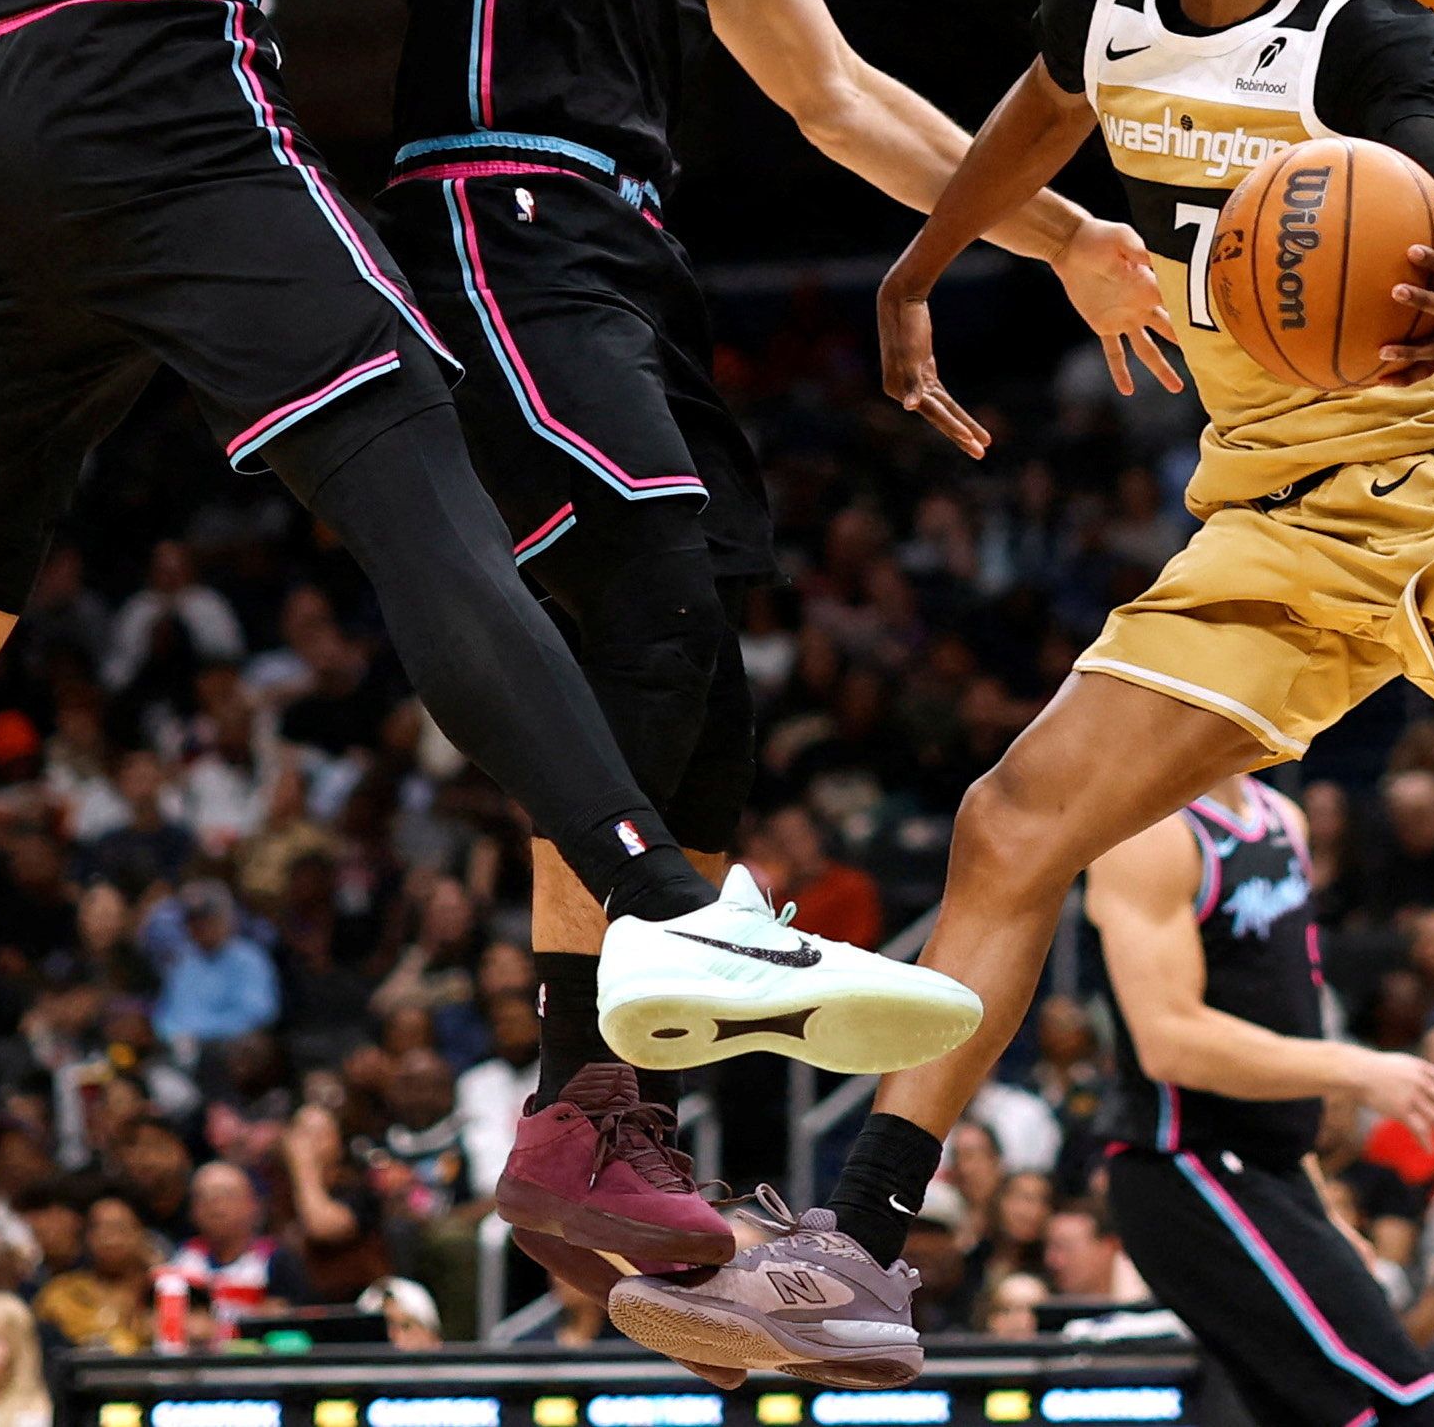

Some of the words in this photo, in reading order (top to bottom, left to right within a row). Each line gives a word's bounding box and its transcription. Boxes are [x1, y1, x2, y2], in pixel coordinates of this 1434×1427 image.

[1234, 77, 1287, 95] Robinhood
[1173, 201, 1221, 333] 7
[1276, 166, 1333, 331] Wilson
[766, 1271, 826, 1304] N
